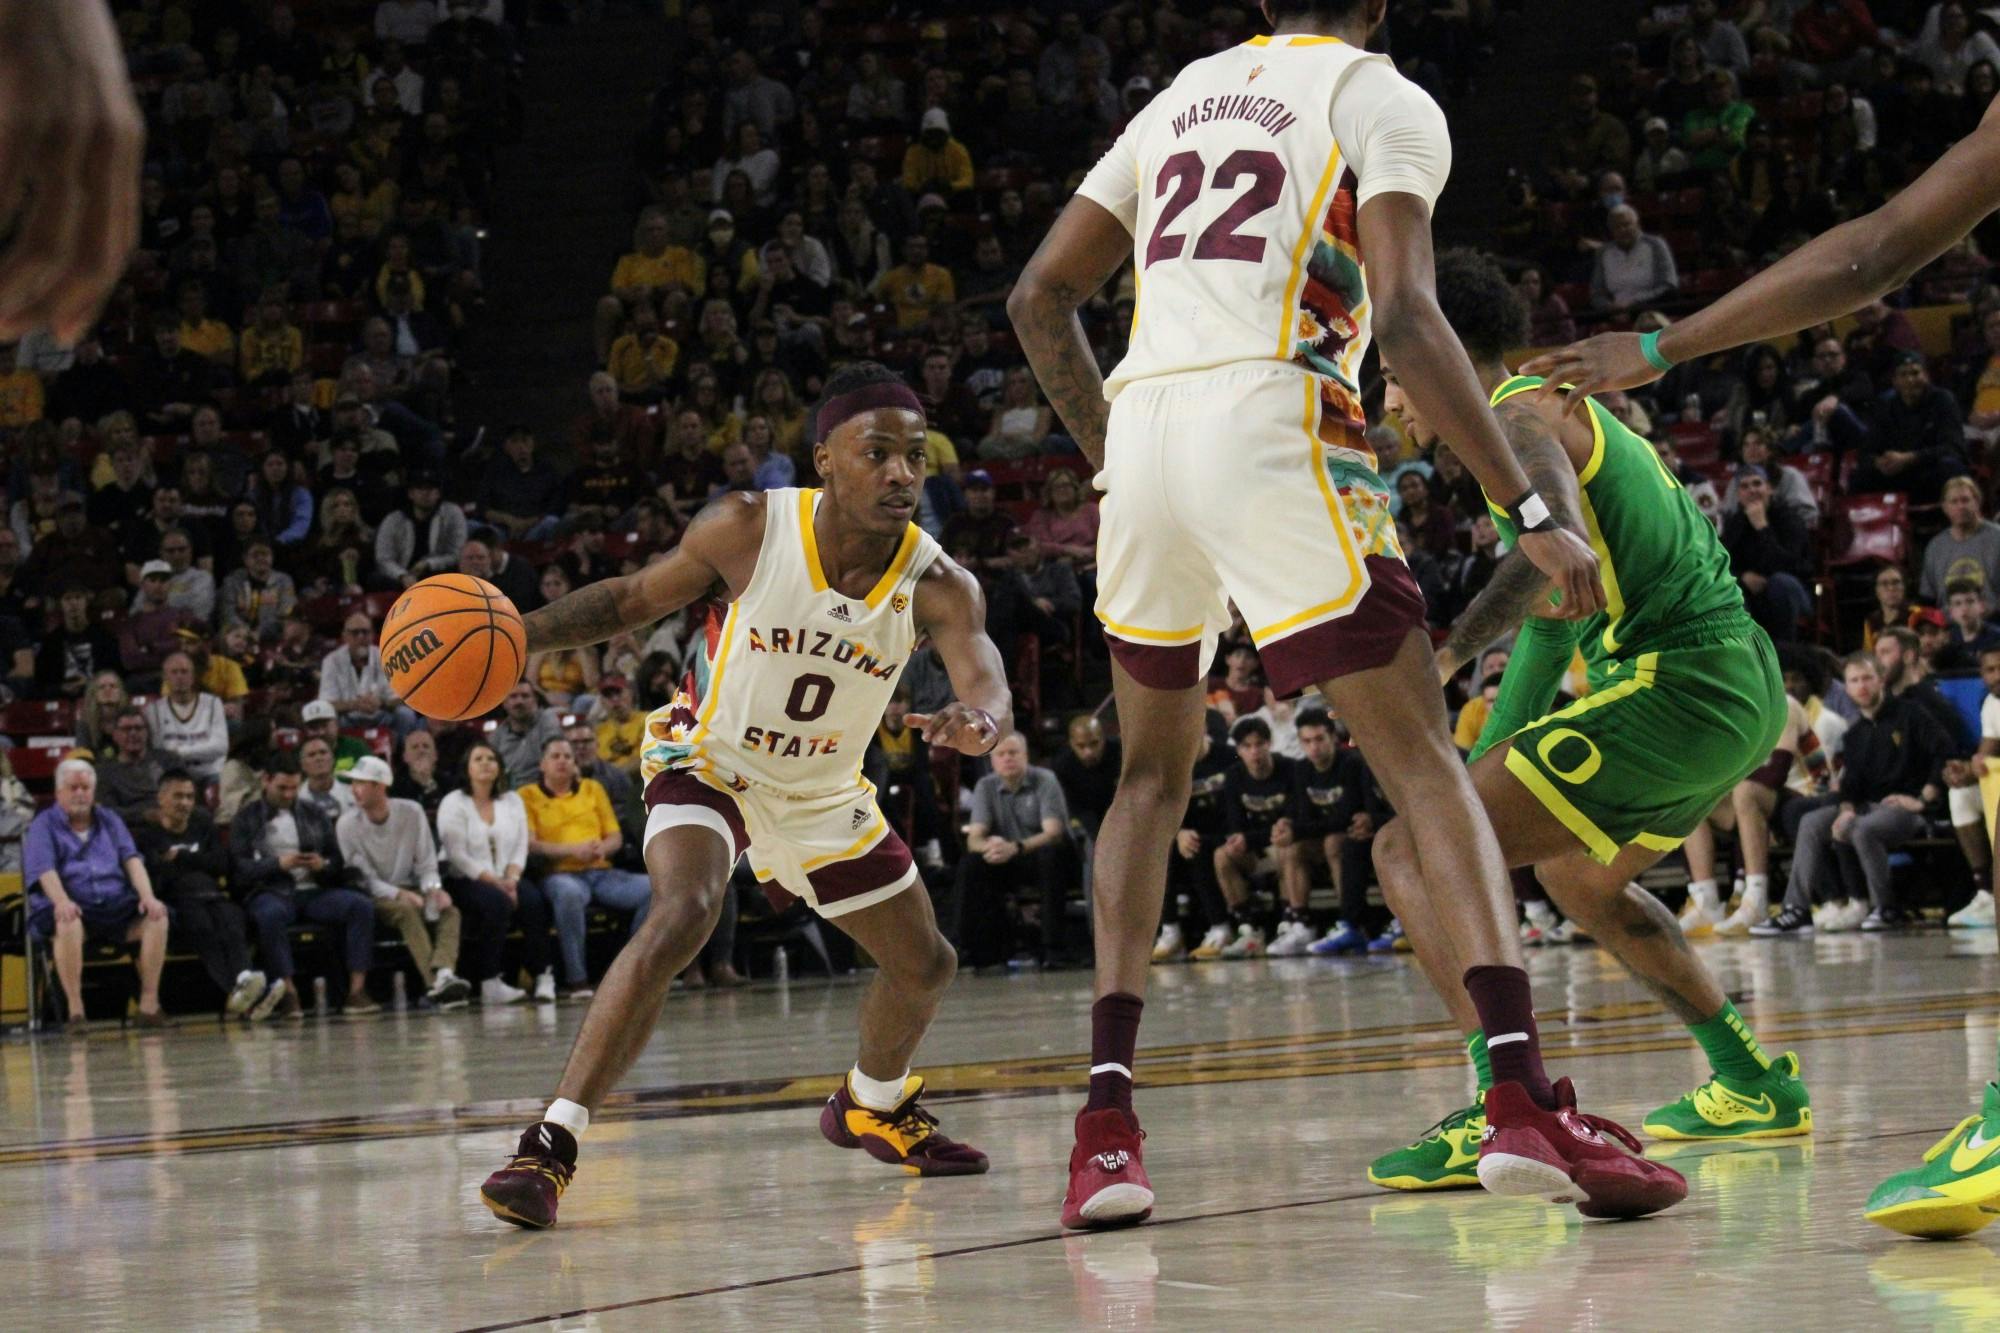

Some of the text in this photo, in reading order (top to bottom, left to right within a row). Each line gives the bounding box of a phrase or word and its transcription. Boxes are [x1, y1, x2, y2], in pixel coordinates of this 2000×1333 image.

[1172, 95, 1297, 139] WASHINGTON
[1145, 150, 1287, 271] 22
[750, 627, 898, 680] ARIZONA
[743, 726, 840, 757] STATE
